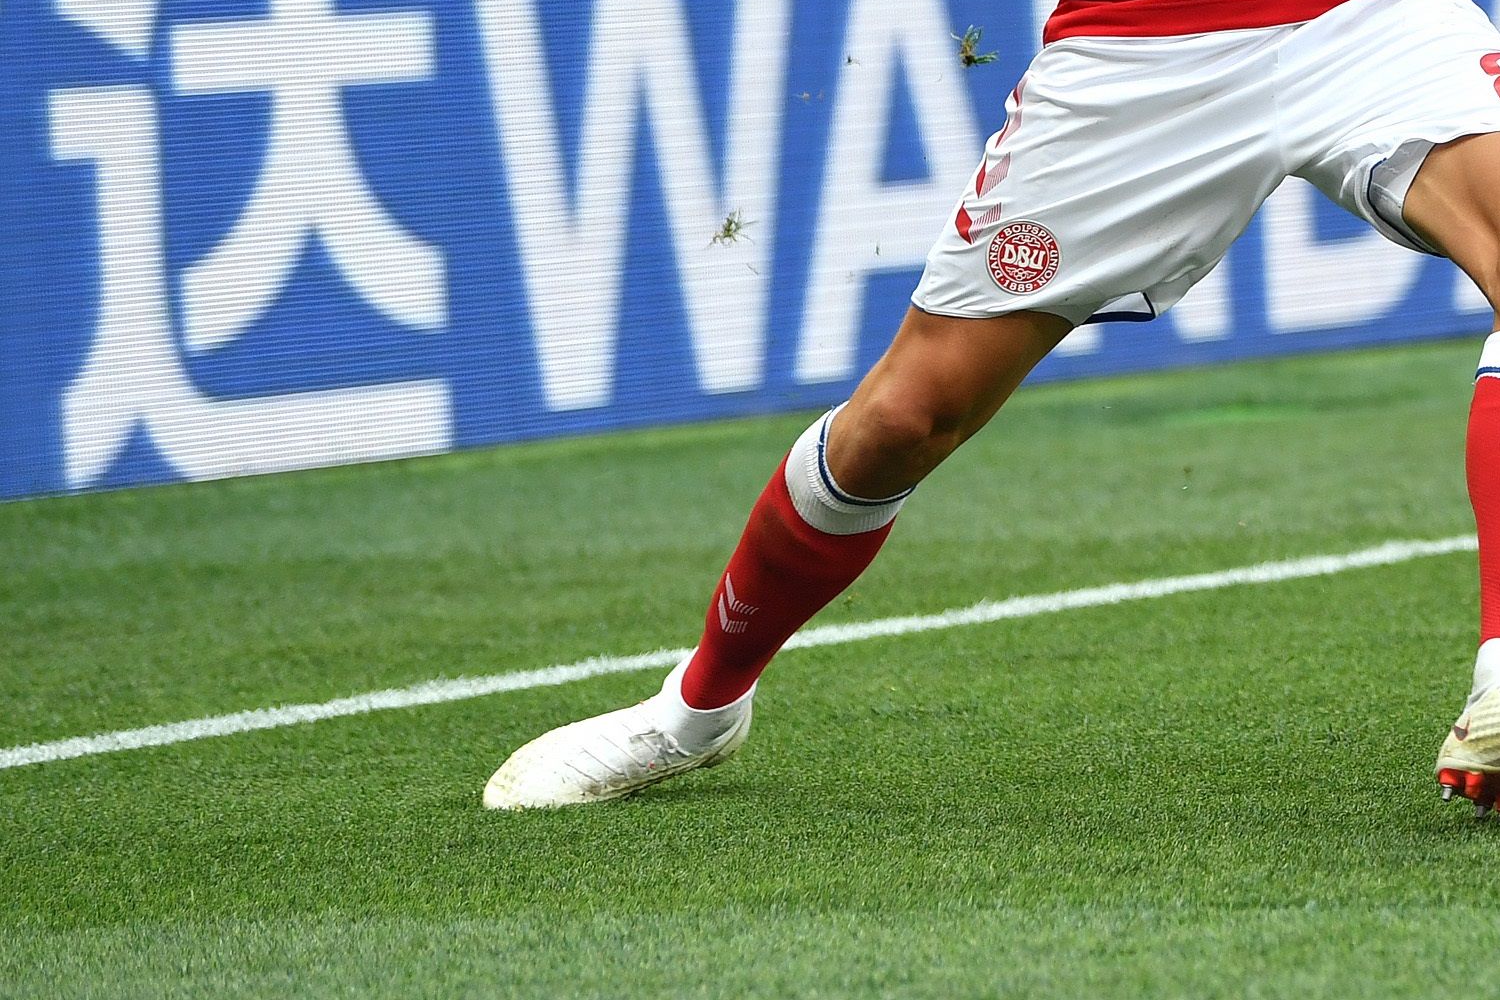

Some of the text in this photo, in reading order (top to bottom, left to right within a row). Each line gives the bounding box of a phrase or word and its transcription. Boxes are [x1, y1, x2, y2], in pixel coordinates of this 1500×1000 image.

[989, 224, 1058, 292] DANSK BOLDSPIL UNION 1889
[1001, 243, 1046, 270] DBU
